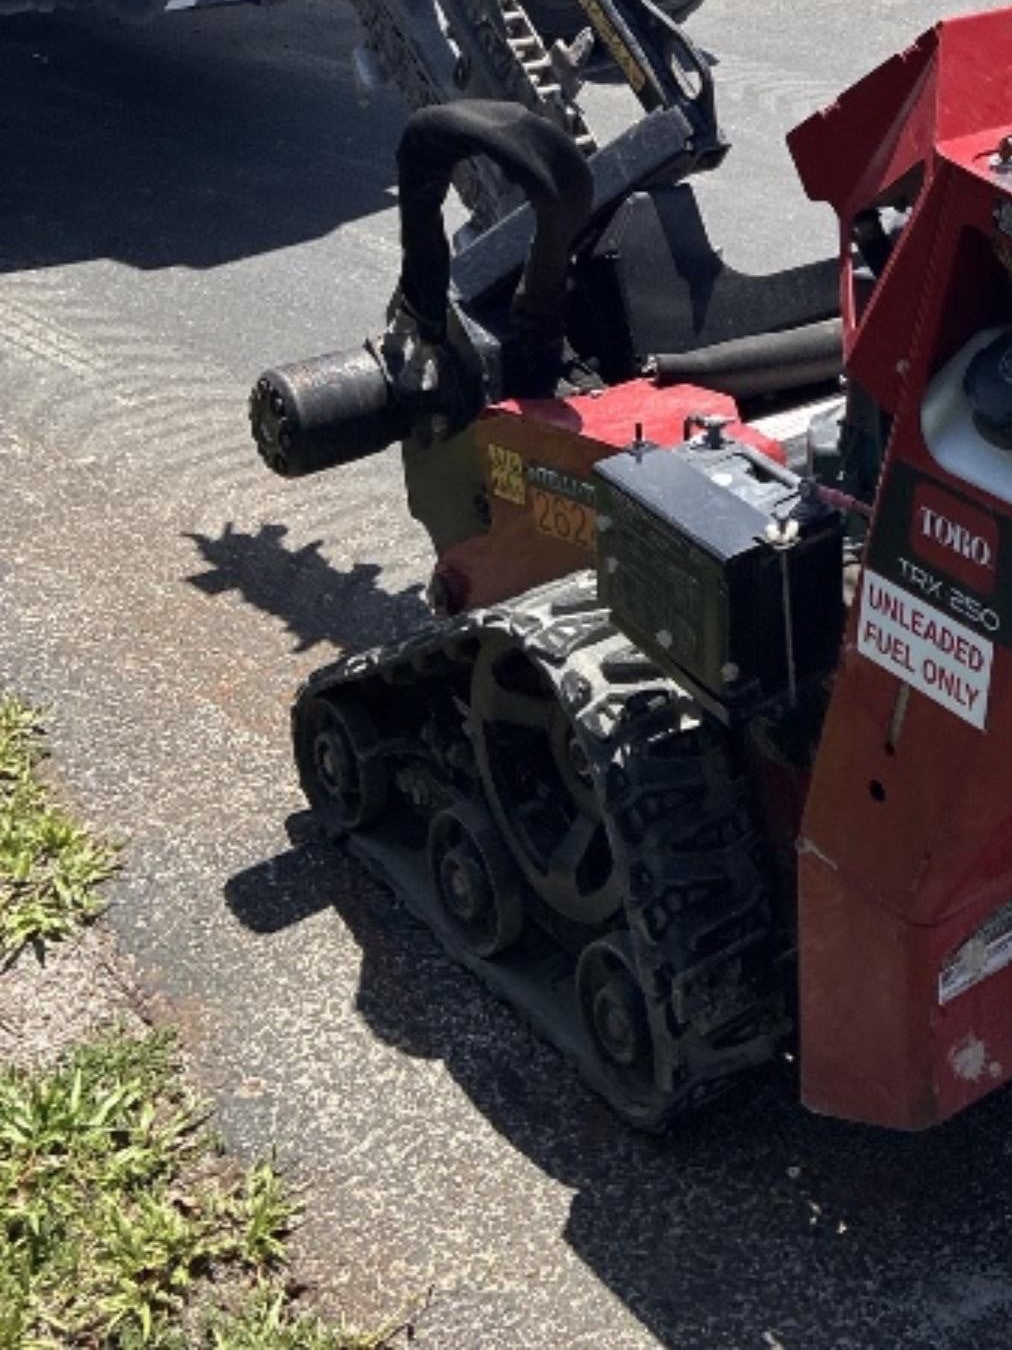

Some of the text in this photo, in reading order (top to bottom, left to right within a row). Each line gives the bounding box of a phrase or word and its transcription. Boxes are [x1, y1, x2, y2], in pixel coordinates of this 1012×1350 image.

[535, 492, 597, 546] 262
[920, 506, 992, 567] TORO
[869, 584, 985, 673] UNLEADED
[899, 557, 1000, 632] TRX 250
[863, 620, 981, 712] FUEL ONLY
